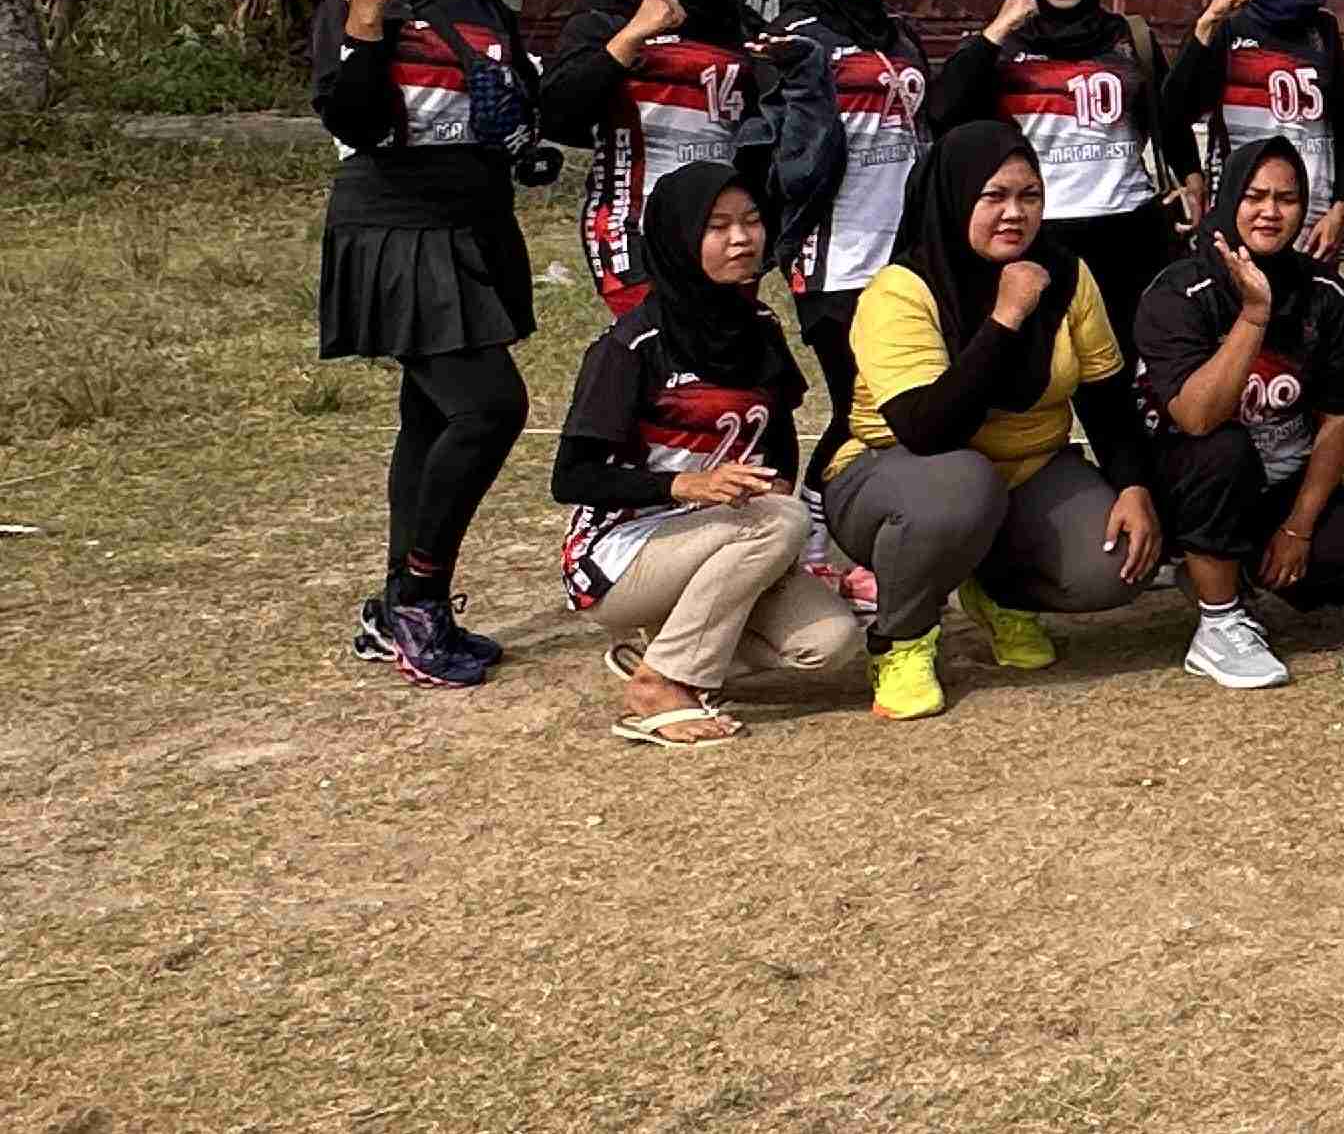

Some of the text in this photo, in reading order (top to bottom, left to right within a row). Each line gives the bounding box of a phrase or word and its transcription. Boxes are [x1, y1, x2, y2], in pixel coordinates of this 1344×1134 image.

[700, 63, 744, 121] 14
[1067, 71, 1122, 126] 10
[1268, 68, 1323, 121] 05
